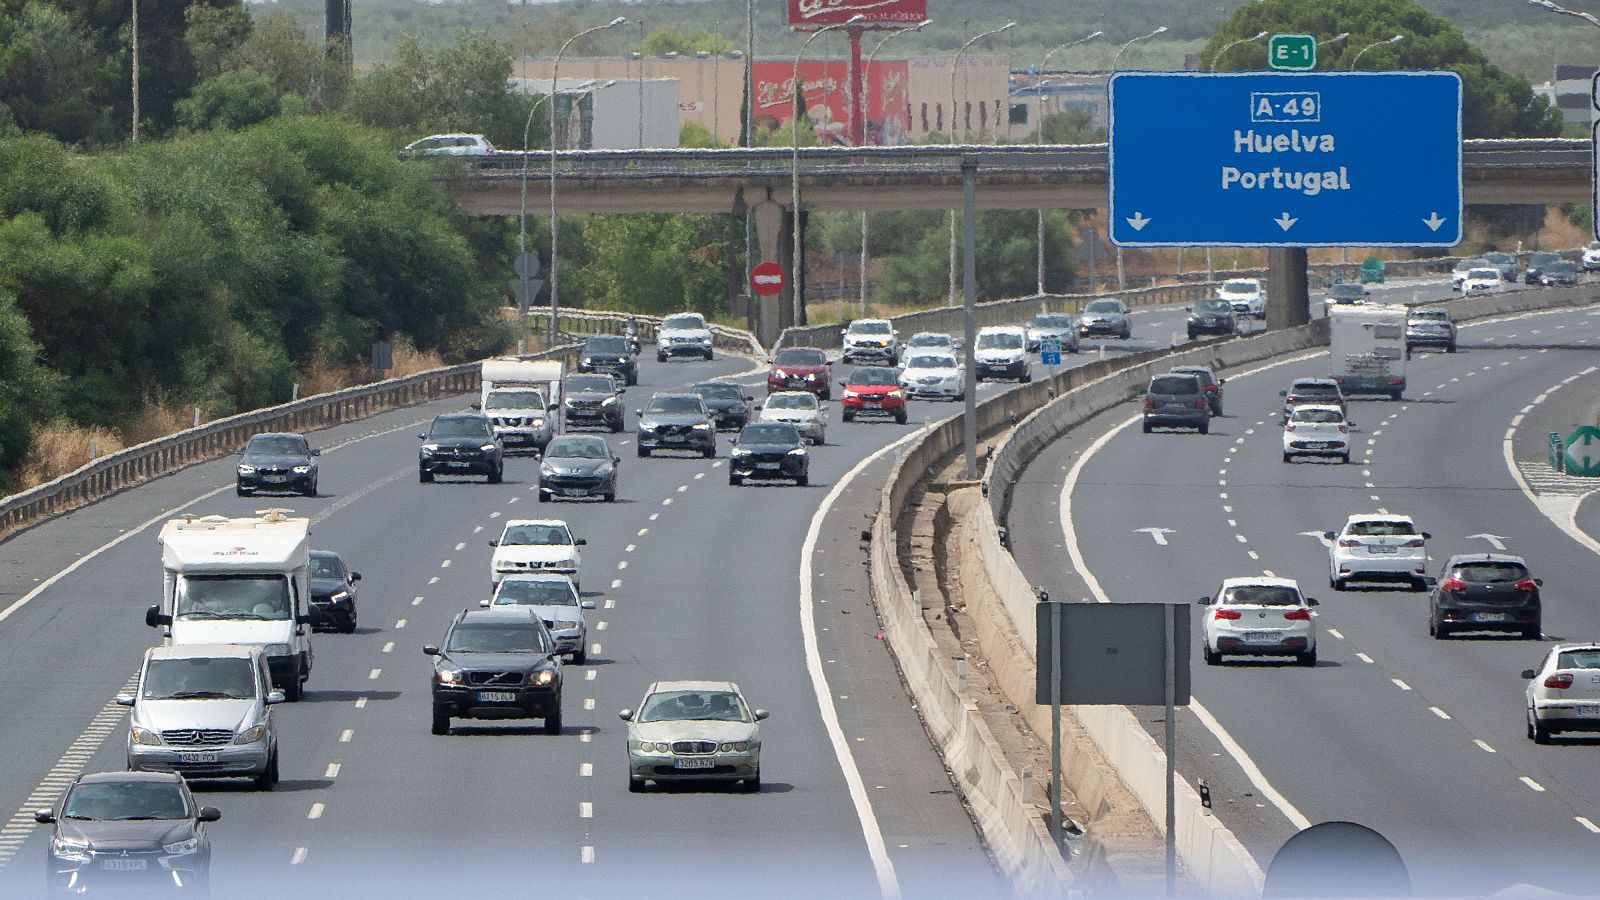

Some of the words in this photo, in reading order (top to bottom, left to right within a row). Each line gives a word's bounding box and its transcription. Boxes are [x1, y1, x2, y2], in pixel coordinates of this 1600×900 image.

[1277, 45, 1309, 59] E-1
[1257, 97, 1317, 117] A-49
[1234, 129, 1335, 153] Huelva
[1222, 165, 1351, 195] Portugal
